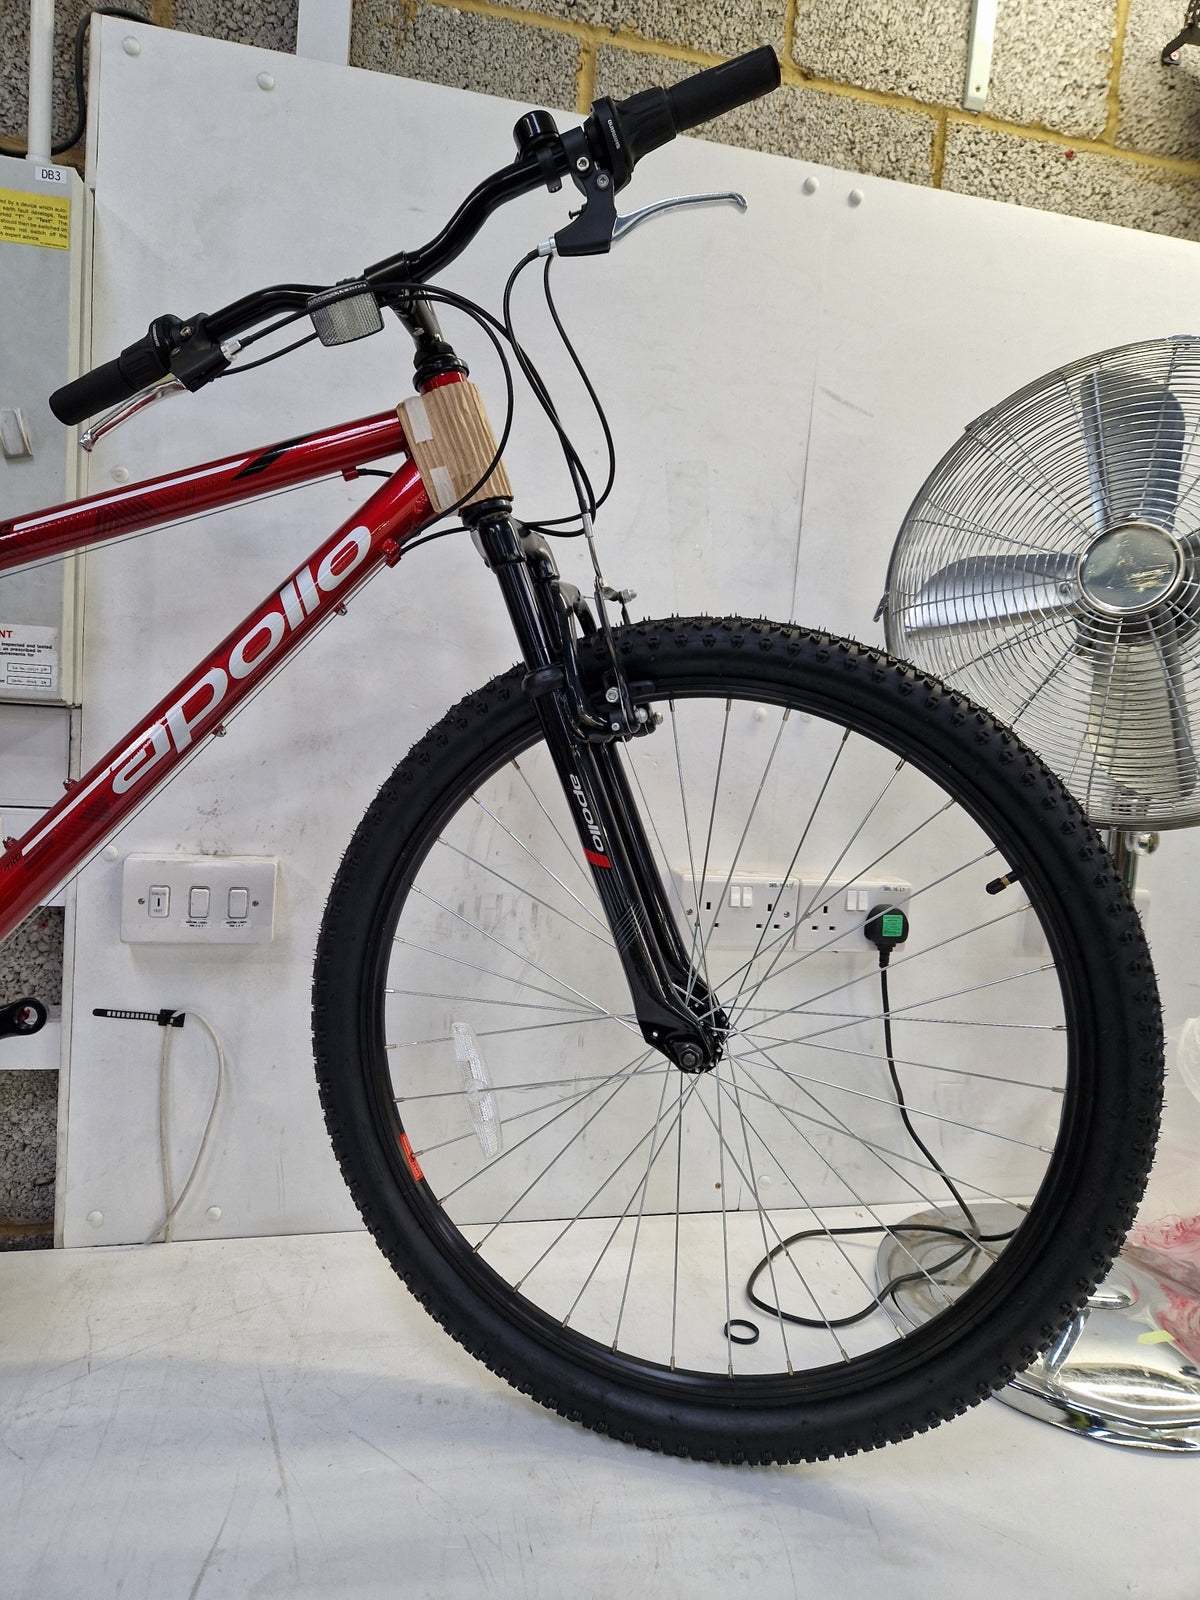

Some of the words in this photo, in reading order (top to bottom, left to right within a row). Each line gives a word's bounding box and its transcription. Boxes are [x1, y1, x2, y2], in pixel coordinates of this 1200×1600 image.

[41, 168, 61, 181] DB3
[112, 525, 372, 794] apollo
[569, 773, 605, 852] apollo
